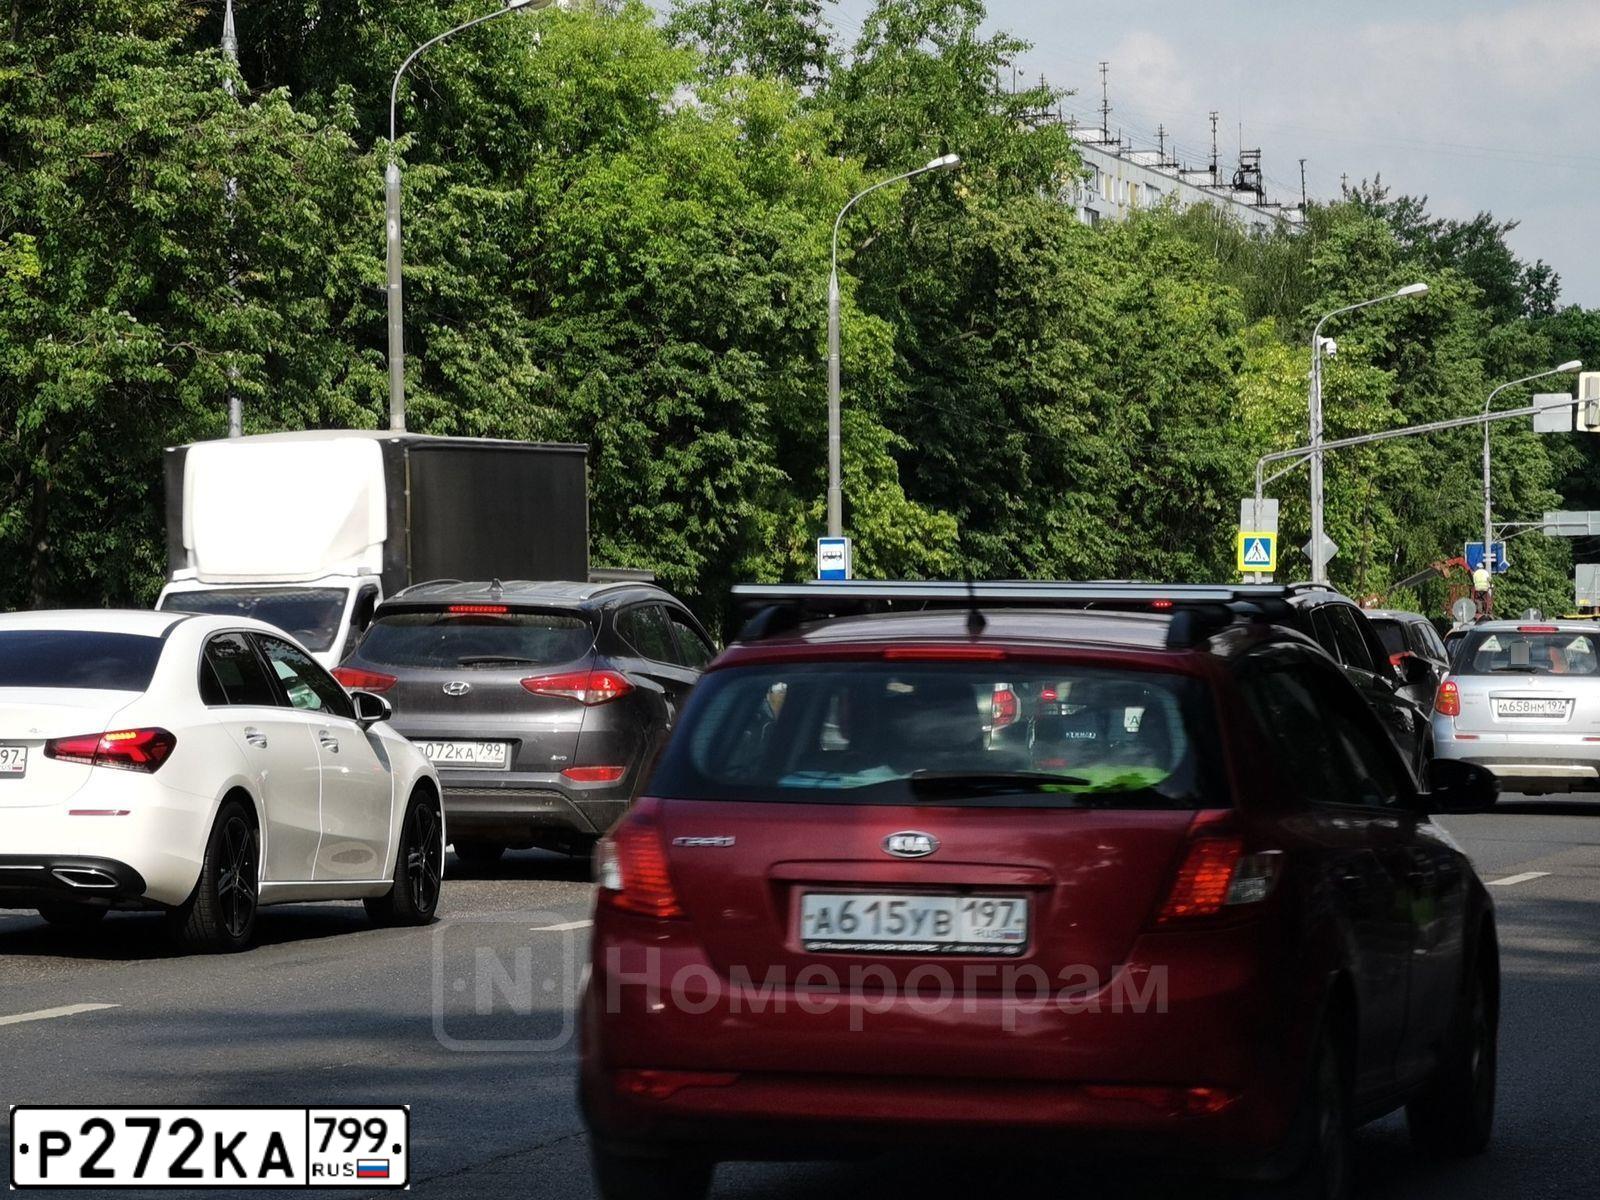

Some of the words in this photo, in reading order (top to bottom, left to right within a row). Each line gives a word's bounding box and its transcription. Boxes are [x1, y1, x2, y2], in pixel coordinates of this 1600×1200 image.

[1501, 701, 1545, 712] А658НМ
[1548, 701, 1563, 709] 197
[0, 749, 19, 764] 97
[479, 743, 501, 756] 799
[814, 900, 953, 937] А615УВ
[961, 901, 1016, 928] 197
